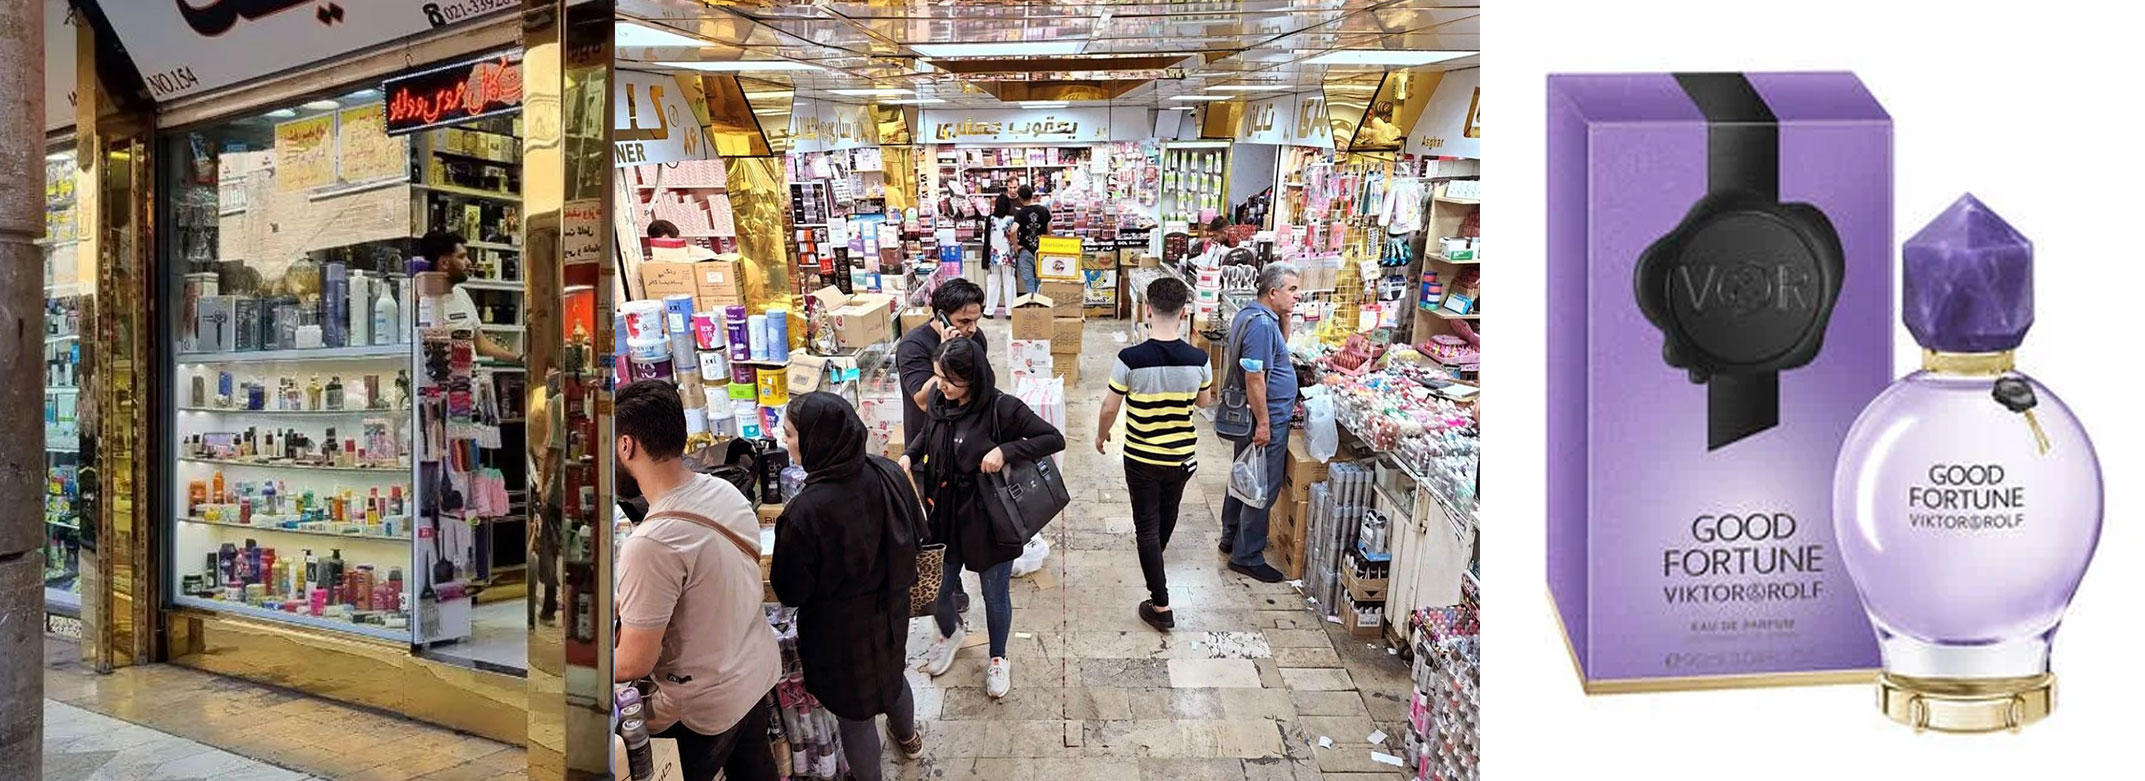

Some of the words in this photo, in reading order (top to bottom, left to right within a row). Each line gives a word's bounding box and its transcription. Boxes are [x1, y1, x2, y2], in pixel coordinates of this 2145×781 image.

[148, 67, 199, 96] NO.154
[935, 117, 1003, 141] جعفری
[1008, 116, 1079, 140] یعقوب
[1421, 135, 1445, 149] Asghar
[1928, 464, 2005, 486] GOOD
[1908, 486, 2025, 510] FORTUNE
[1692, 512, 1797, 543] GOOD
[1663, 544, 1825, 577] FORTUNE
[1721, 620, 1738, 631] DE
